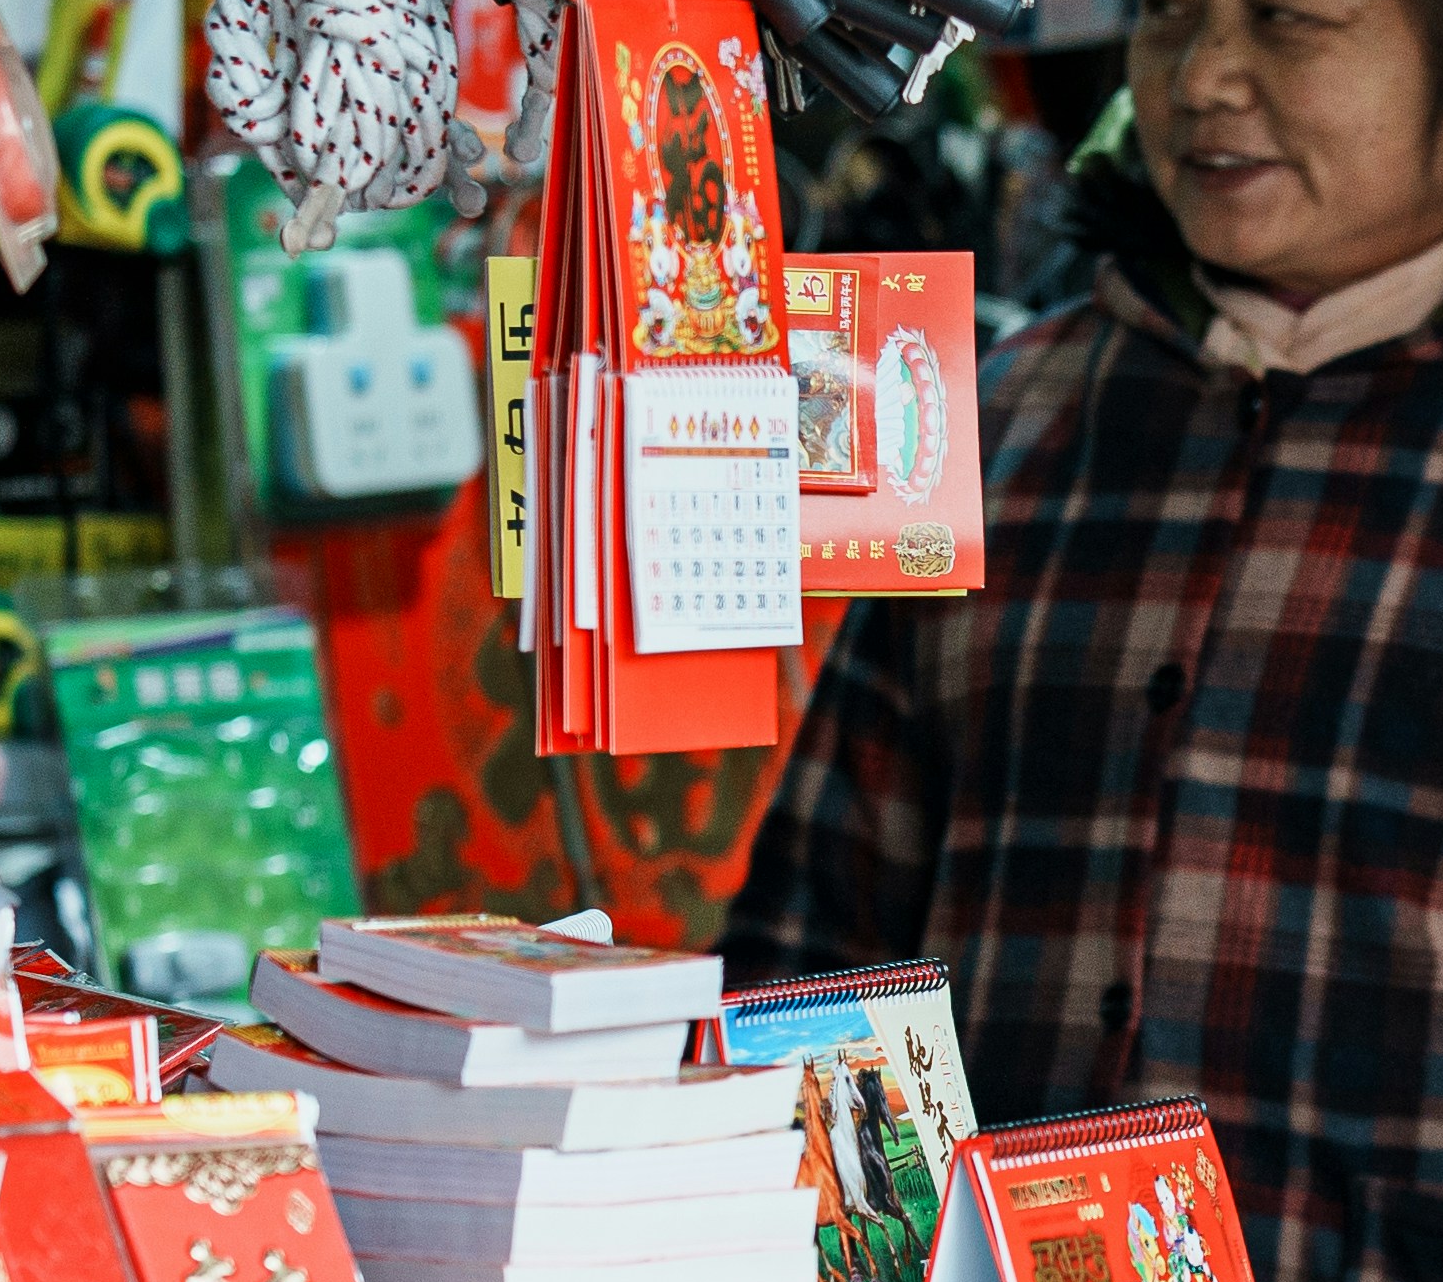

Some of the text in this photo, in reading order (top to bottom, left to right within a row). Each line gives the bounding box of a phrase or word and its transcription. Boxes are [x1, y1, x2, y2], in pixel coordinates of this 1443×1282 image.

[840, 274, 853, 330] 马年丙午年
